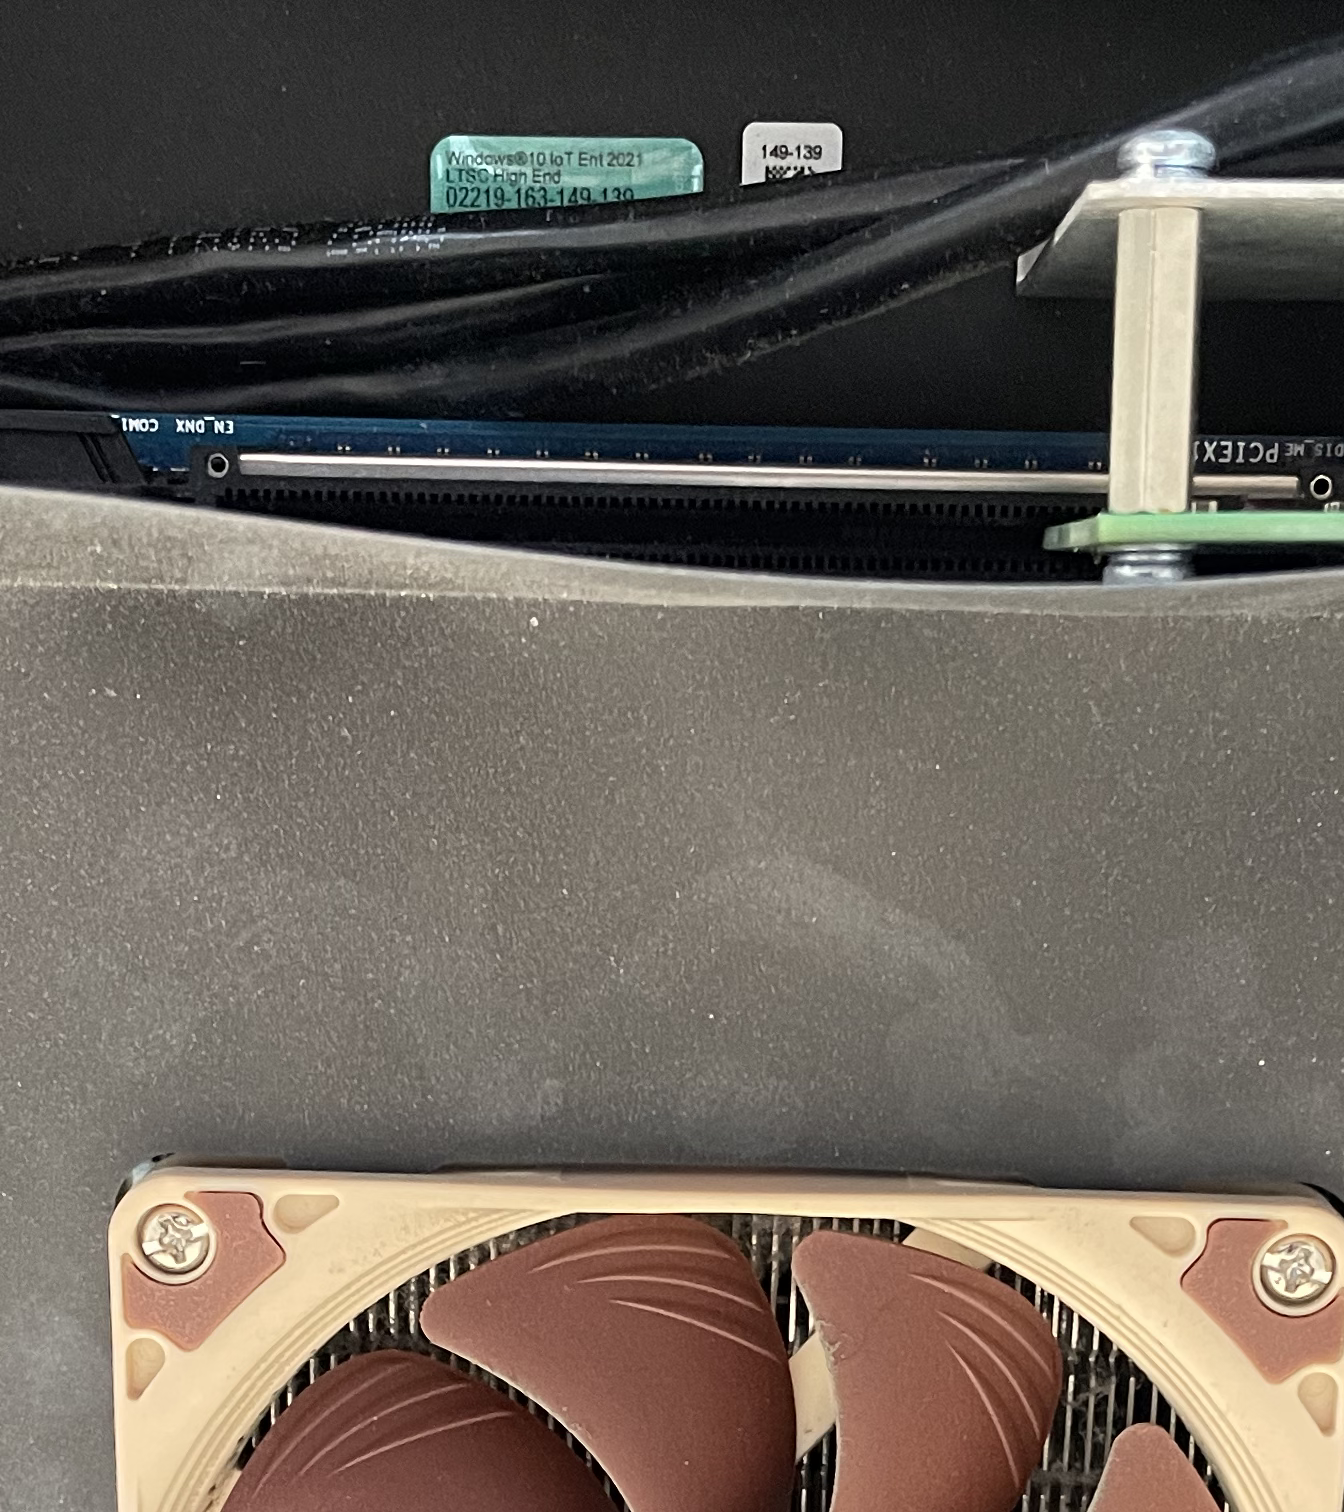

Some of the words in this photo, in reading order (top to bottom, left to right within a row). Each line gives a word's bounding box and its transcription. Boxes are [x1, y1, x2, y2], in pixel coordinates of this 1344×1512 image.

[578, 152, 605, 167] Ent
[606, 152, 643, 168] 2021
[762, 144, 823, 160] 149-139
[446, 168, 489, 184] LTSC
[493, 169, 527, 187] High
[532, 168, 562, 184] End
[175, 416, 234, 434] EN_DNX
